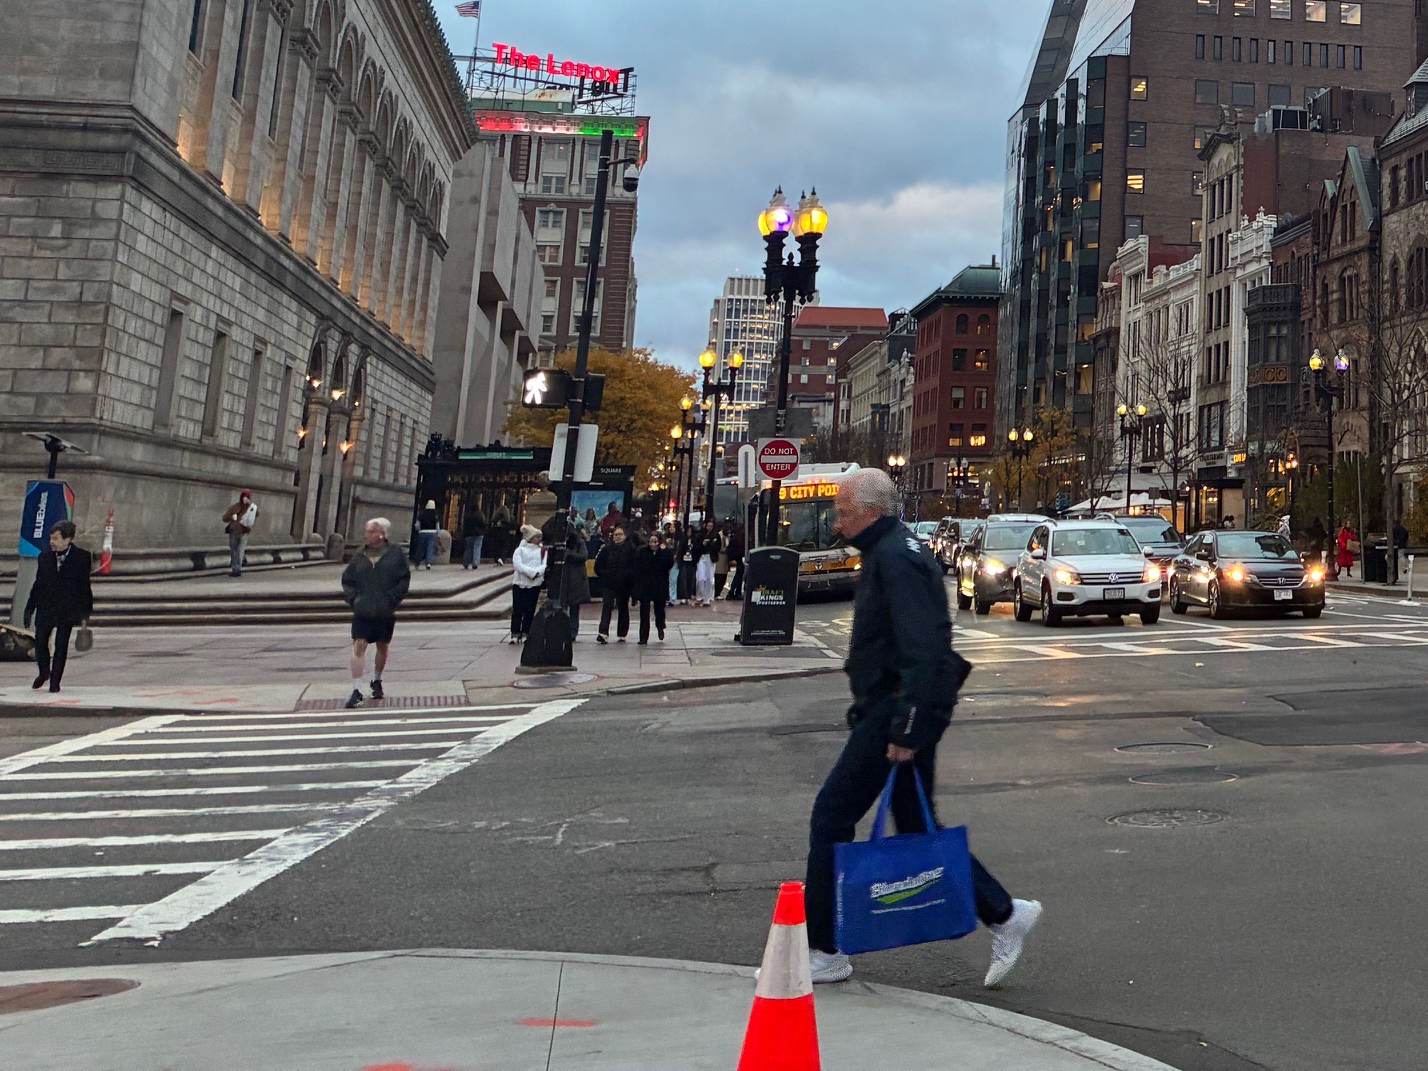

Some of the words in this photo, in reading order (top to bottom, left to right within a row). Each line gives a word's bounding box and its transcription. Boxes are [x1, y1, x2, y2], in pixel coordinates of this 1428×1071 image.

[492, 42, 541, 71] The
[546, 53, 620, 84] Lenox
[790, 485, 815, 499] CITY
[817, 484, 839, 498] POI
